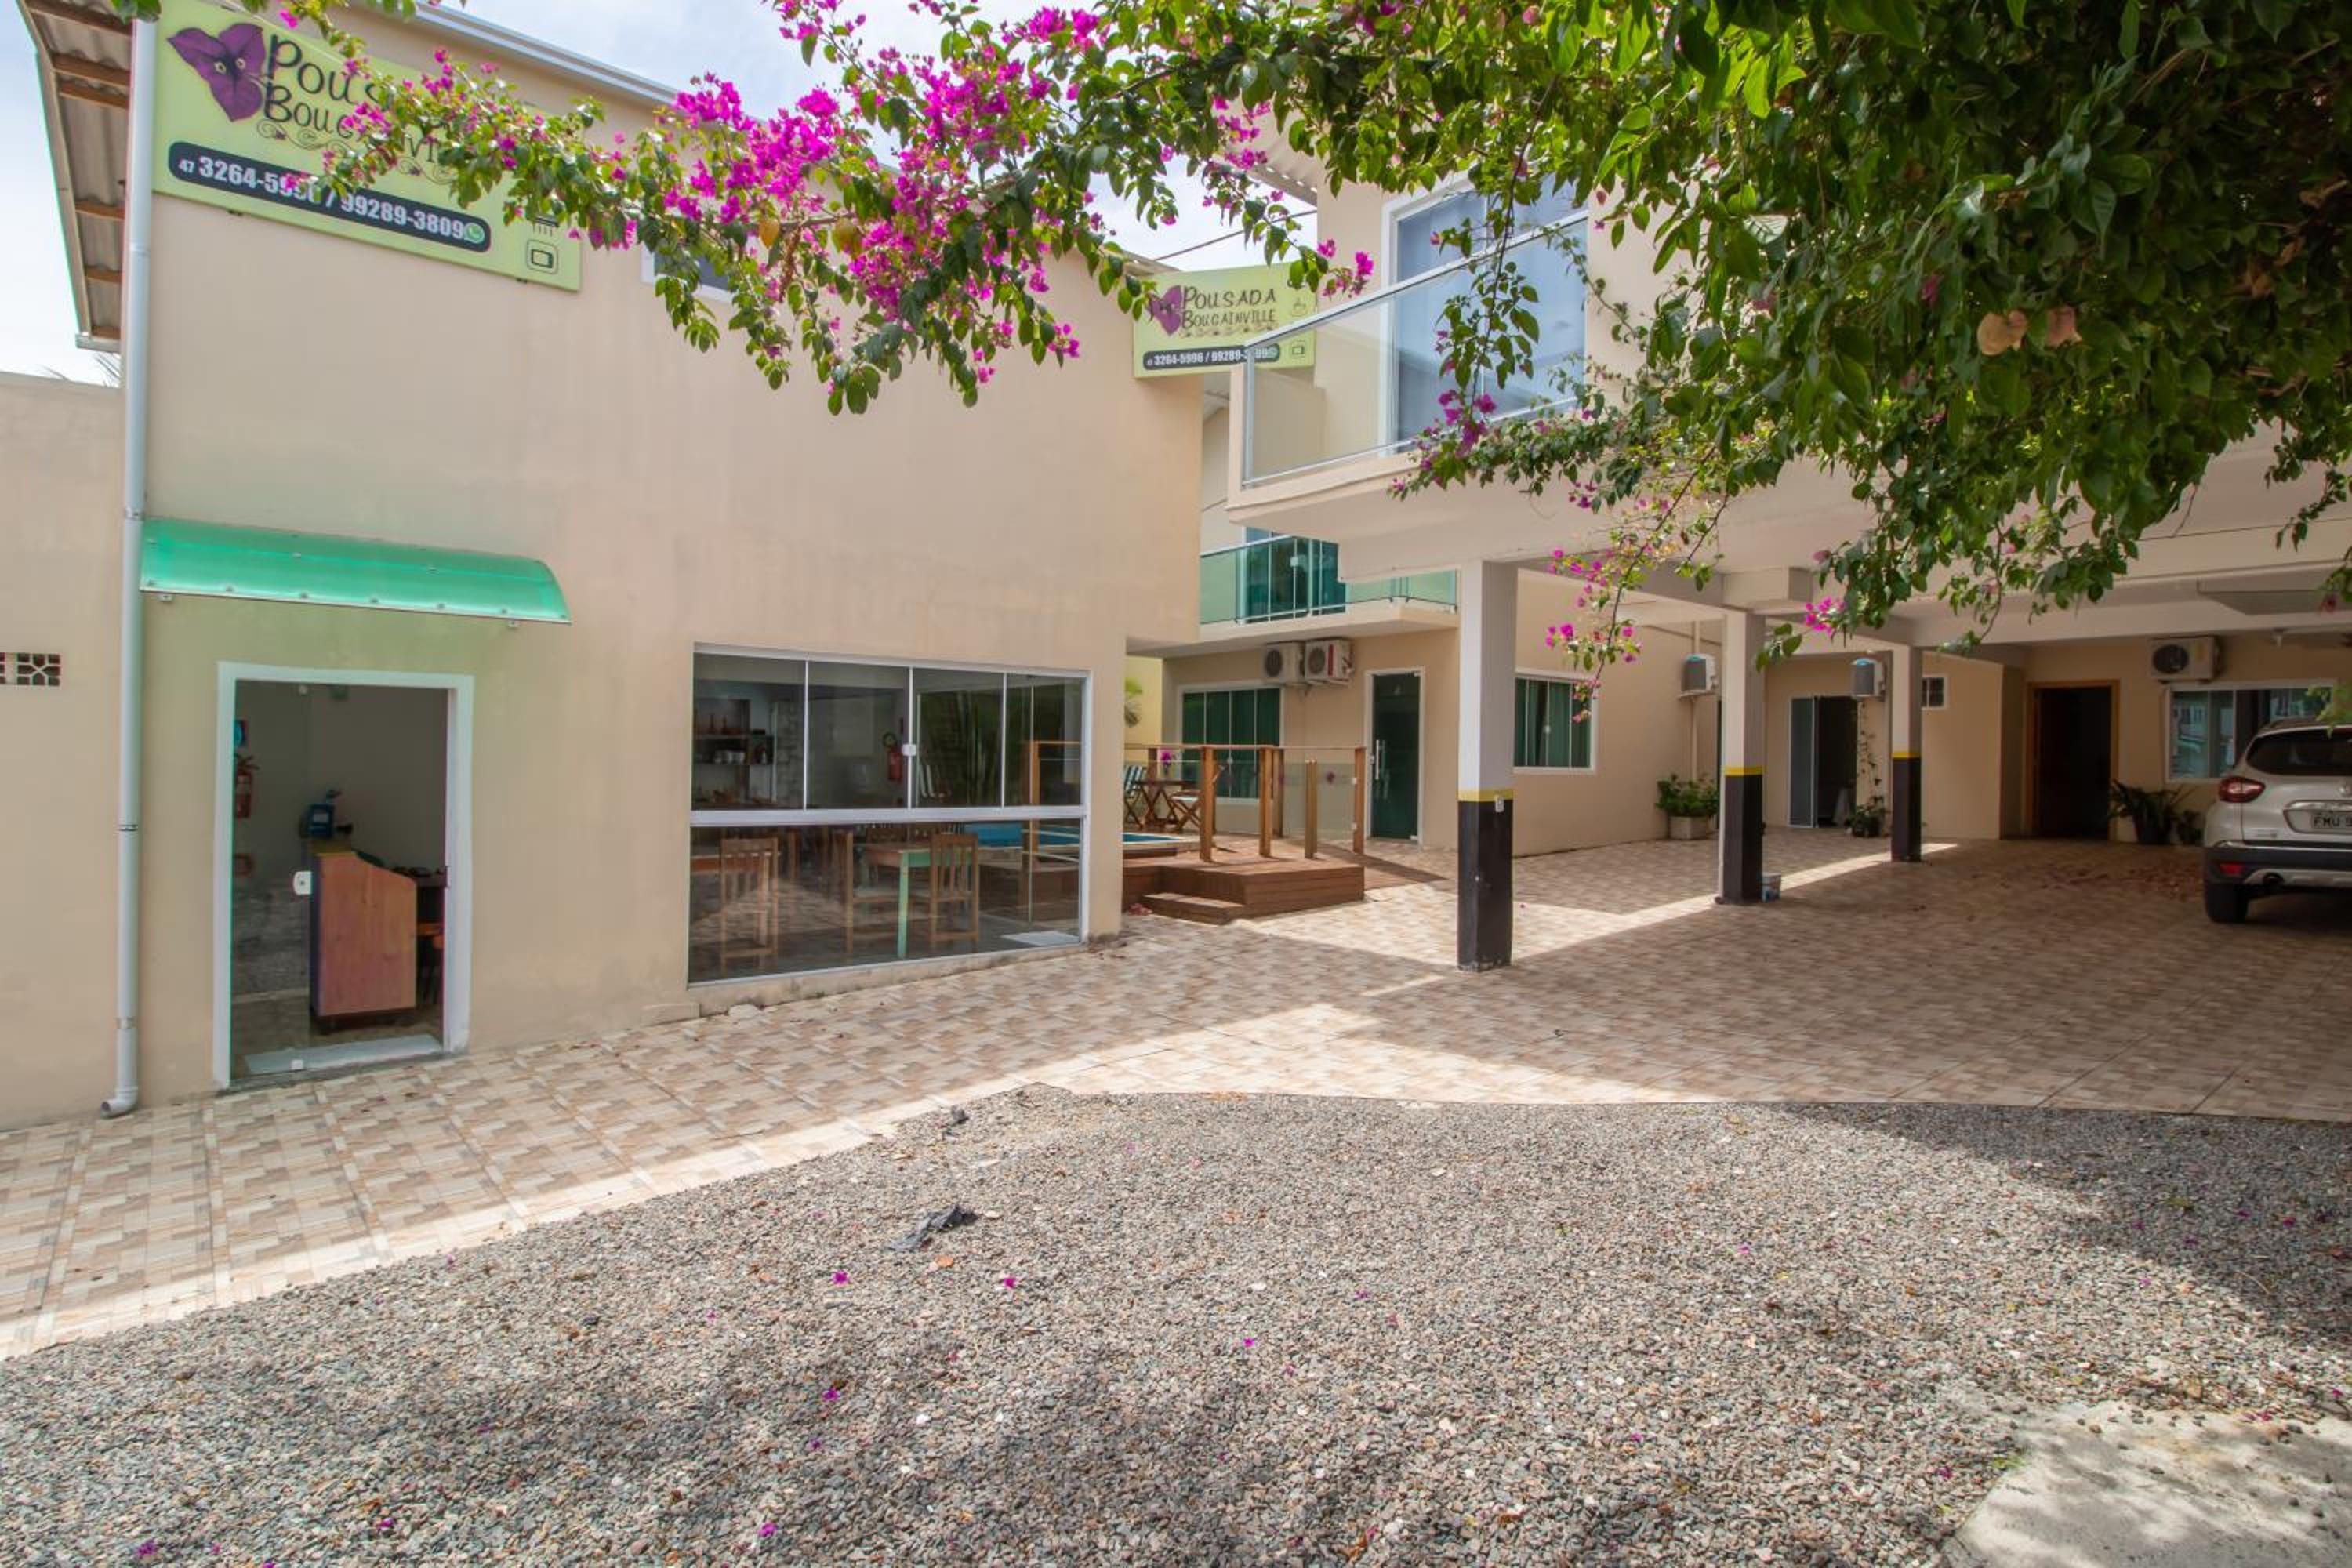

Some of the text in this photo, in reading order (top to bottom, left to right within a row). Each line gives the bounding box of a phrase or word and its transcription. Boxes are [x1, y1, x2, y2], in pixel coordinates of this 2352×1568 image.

[178, 159, 195, 173] 47
[340, 194, 466, 239] 99289-3809
[1181, 285, 1276, 310] POUSADA
